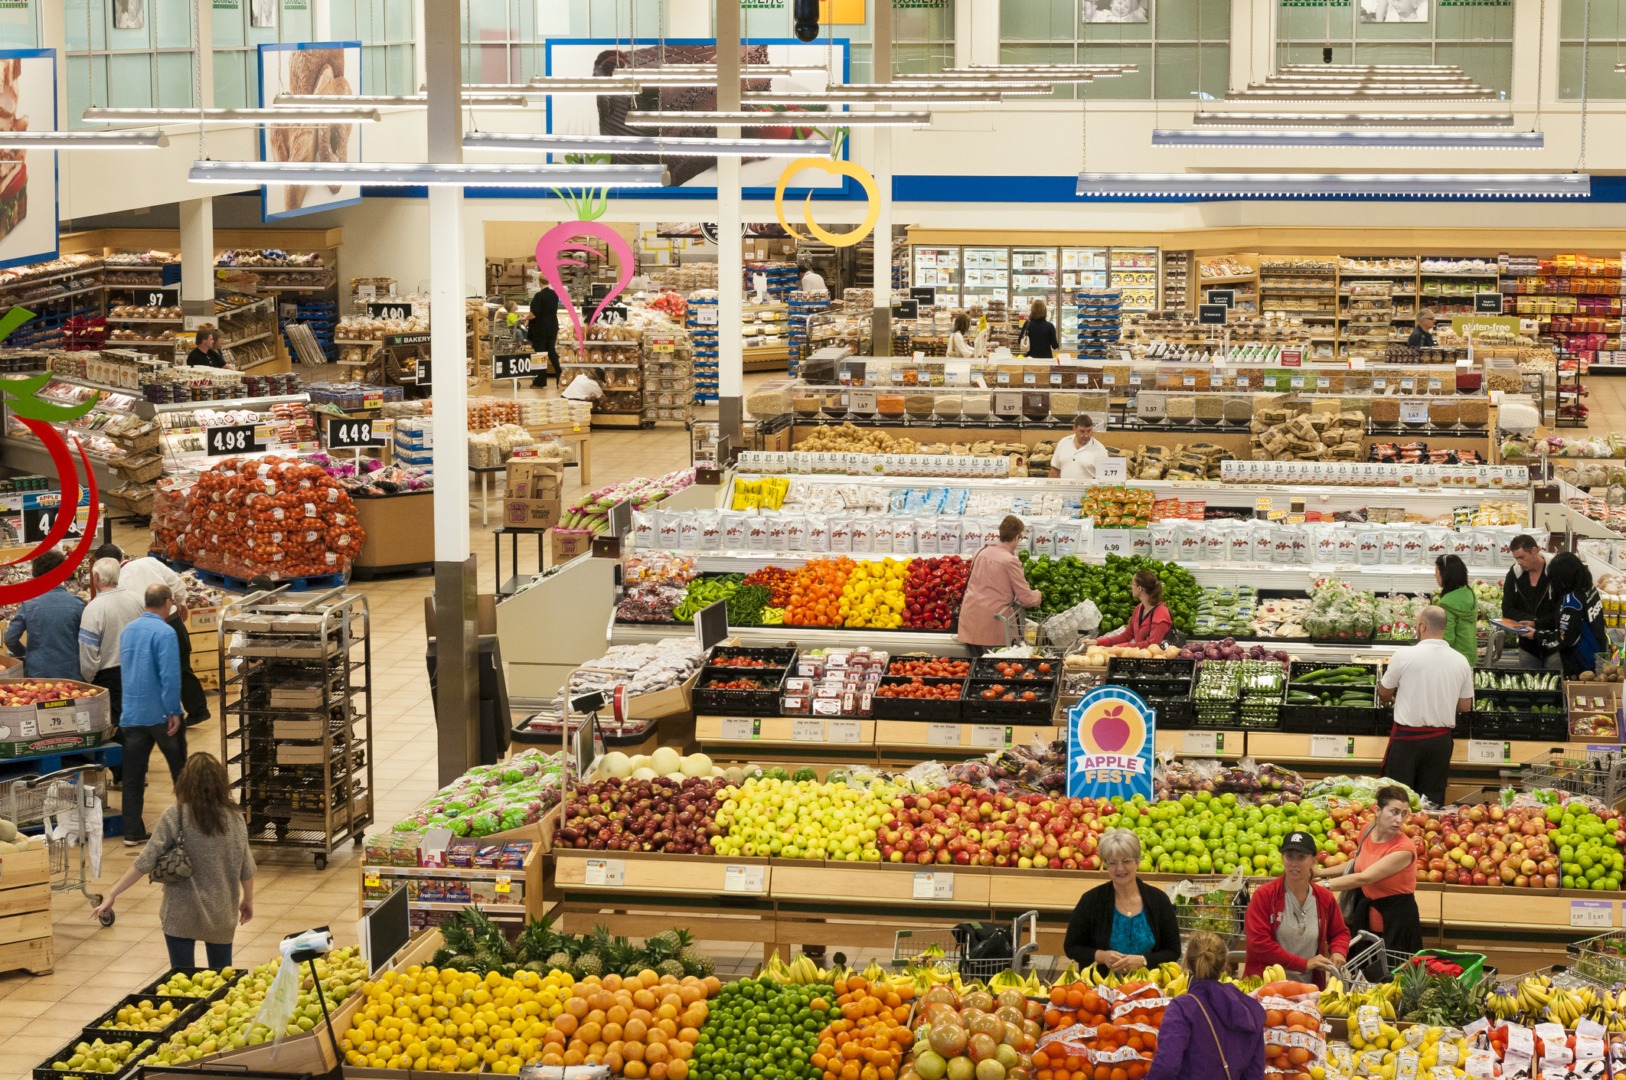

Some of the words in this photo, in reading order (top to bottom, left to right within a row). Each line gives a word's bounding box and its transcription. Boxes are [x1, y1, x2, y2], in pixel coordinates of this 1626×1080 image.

[147, 293, 163, 307] .97
[1462, 323, 1510, 335] gluten-free
[509, 358, 531, 375] 5.00
[339, 423, 370, 443] 4.48
[213, 431, 246, 451] 4.98
[1561, 613, 1571, 621] 99
[1480, 750, 1495, 758] 1.39
[1084, 756, 1138, 770] APPLE
[1084, 769, 1136, 785] FEST
